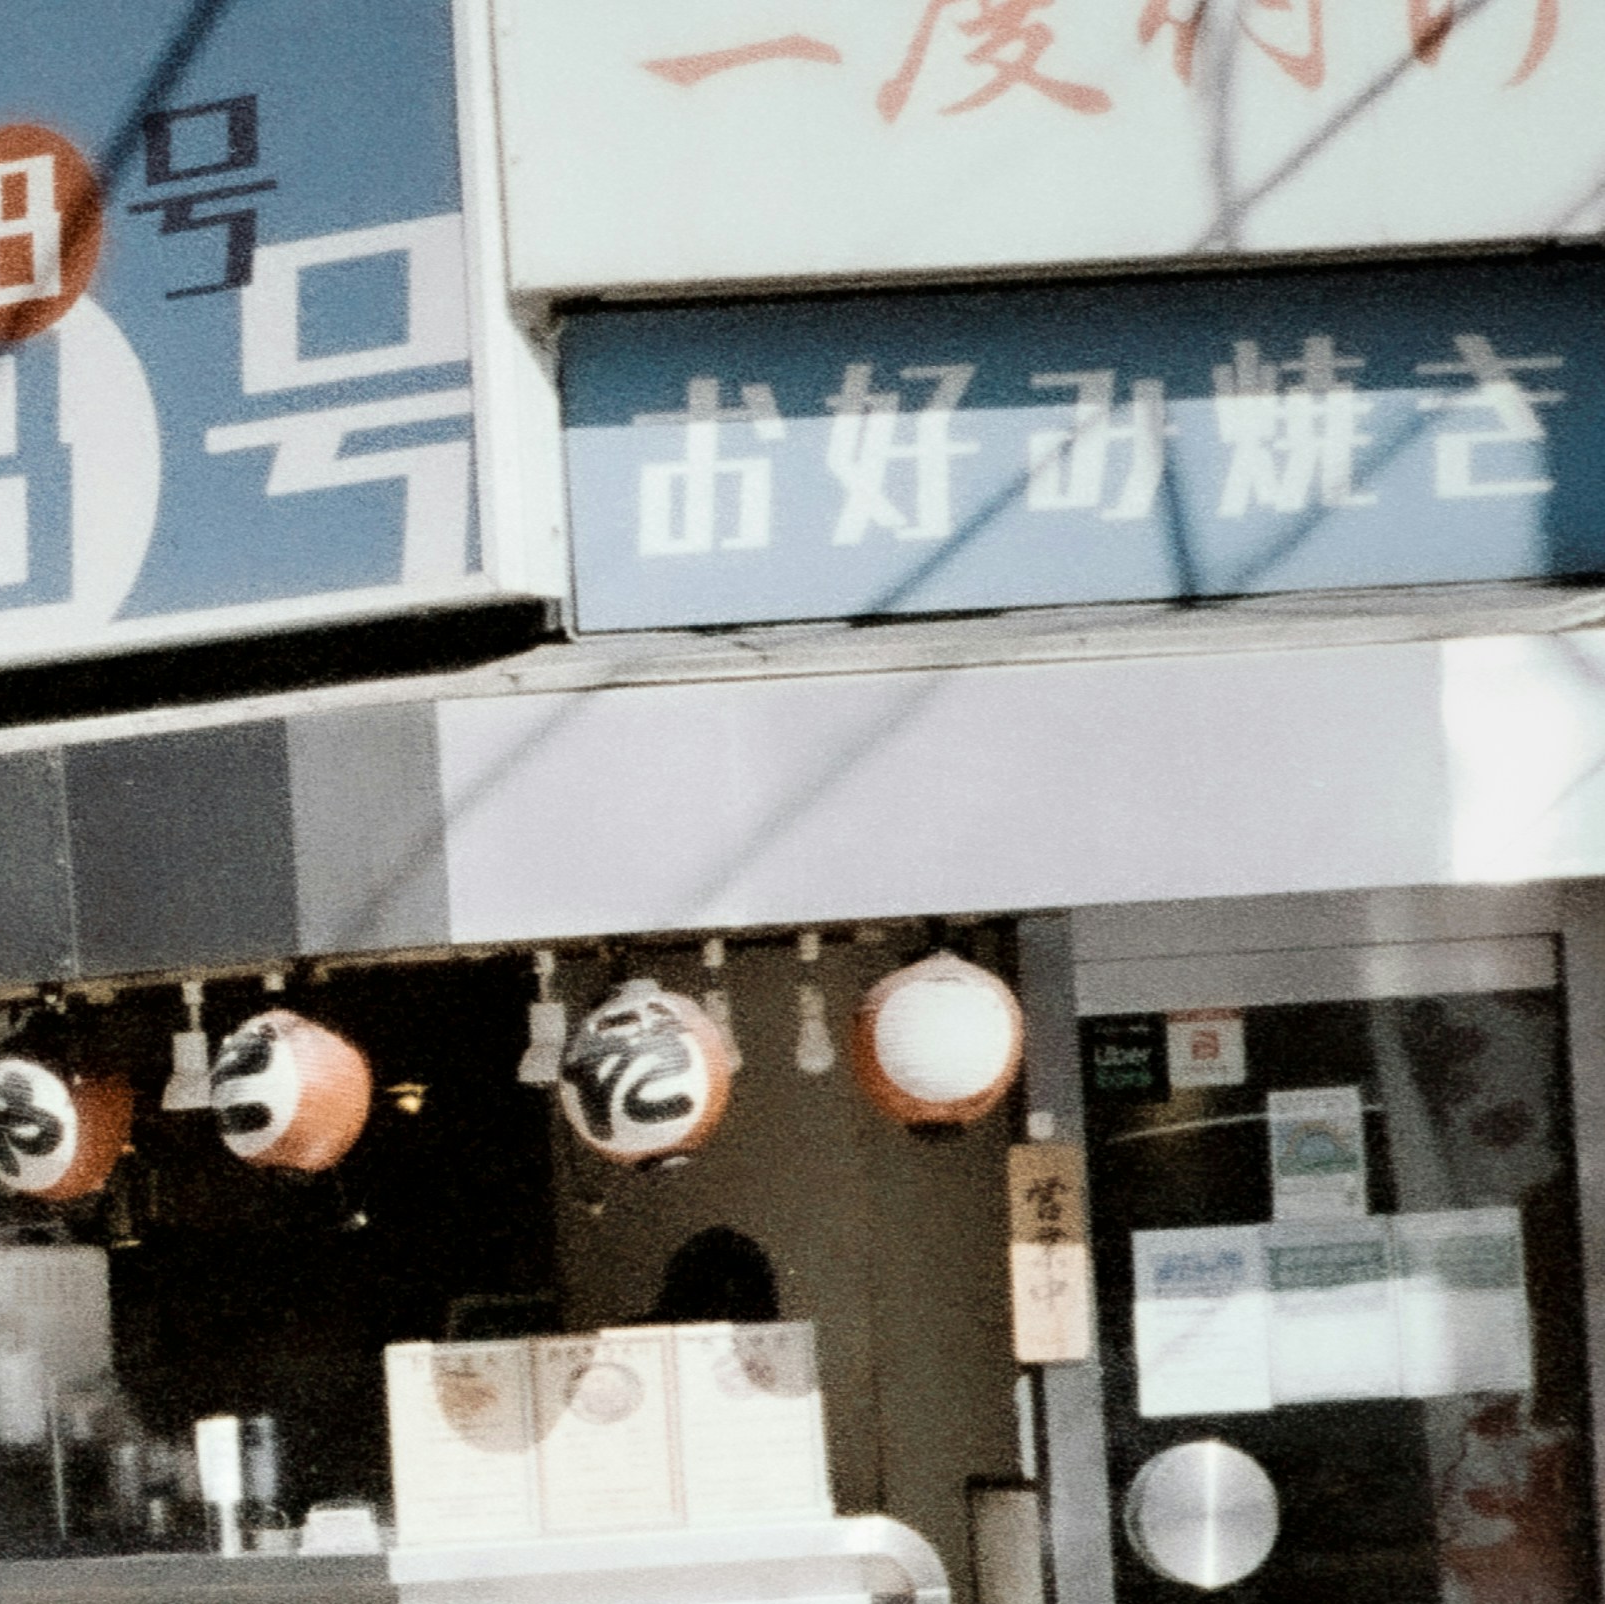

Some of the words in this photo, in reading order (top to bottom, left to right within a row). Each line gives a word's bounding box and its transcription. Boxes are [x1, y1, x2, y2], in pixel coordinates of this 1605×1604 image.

[633, 334, 1565, 558] お好み焼き
